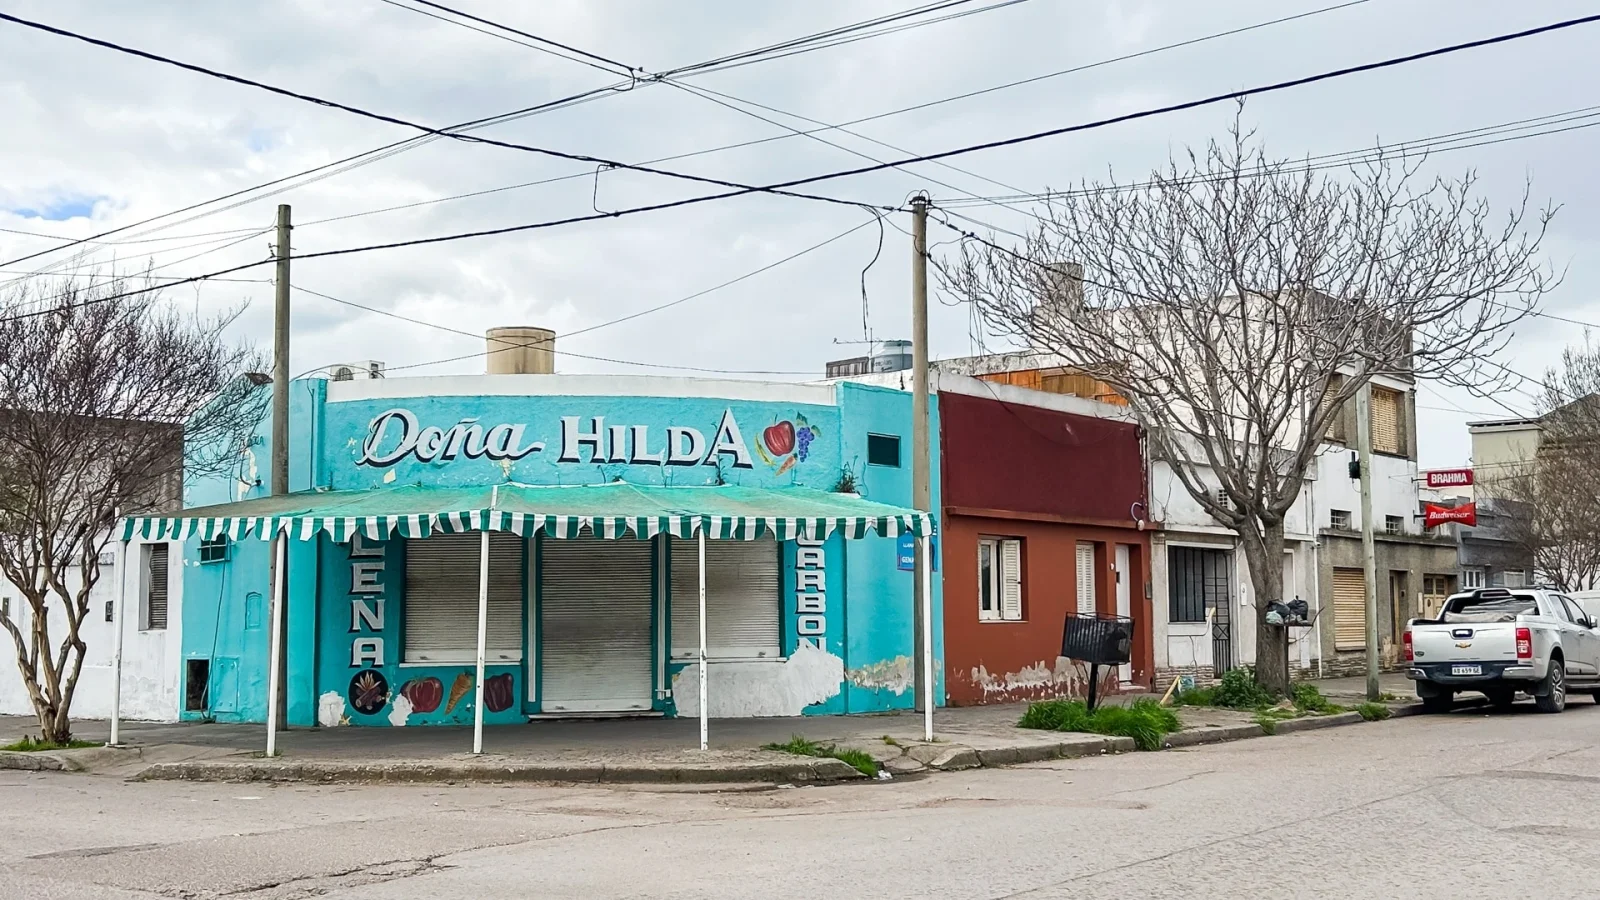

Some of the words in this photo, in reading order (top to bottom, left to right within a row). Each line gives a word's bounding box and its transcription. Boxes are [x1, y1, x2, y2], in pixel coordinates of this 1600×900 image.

[355, 408, 546, 467] Doña
[557, 407, 753, 469] HILDA
[1430, 472, 1468, 484] BRAHMA
[1429, 511, 1470, 519] Budweiser
